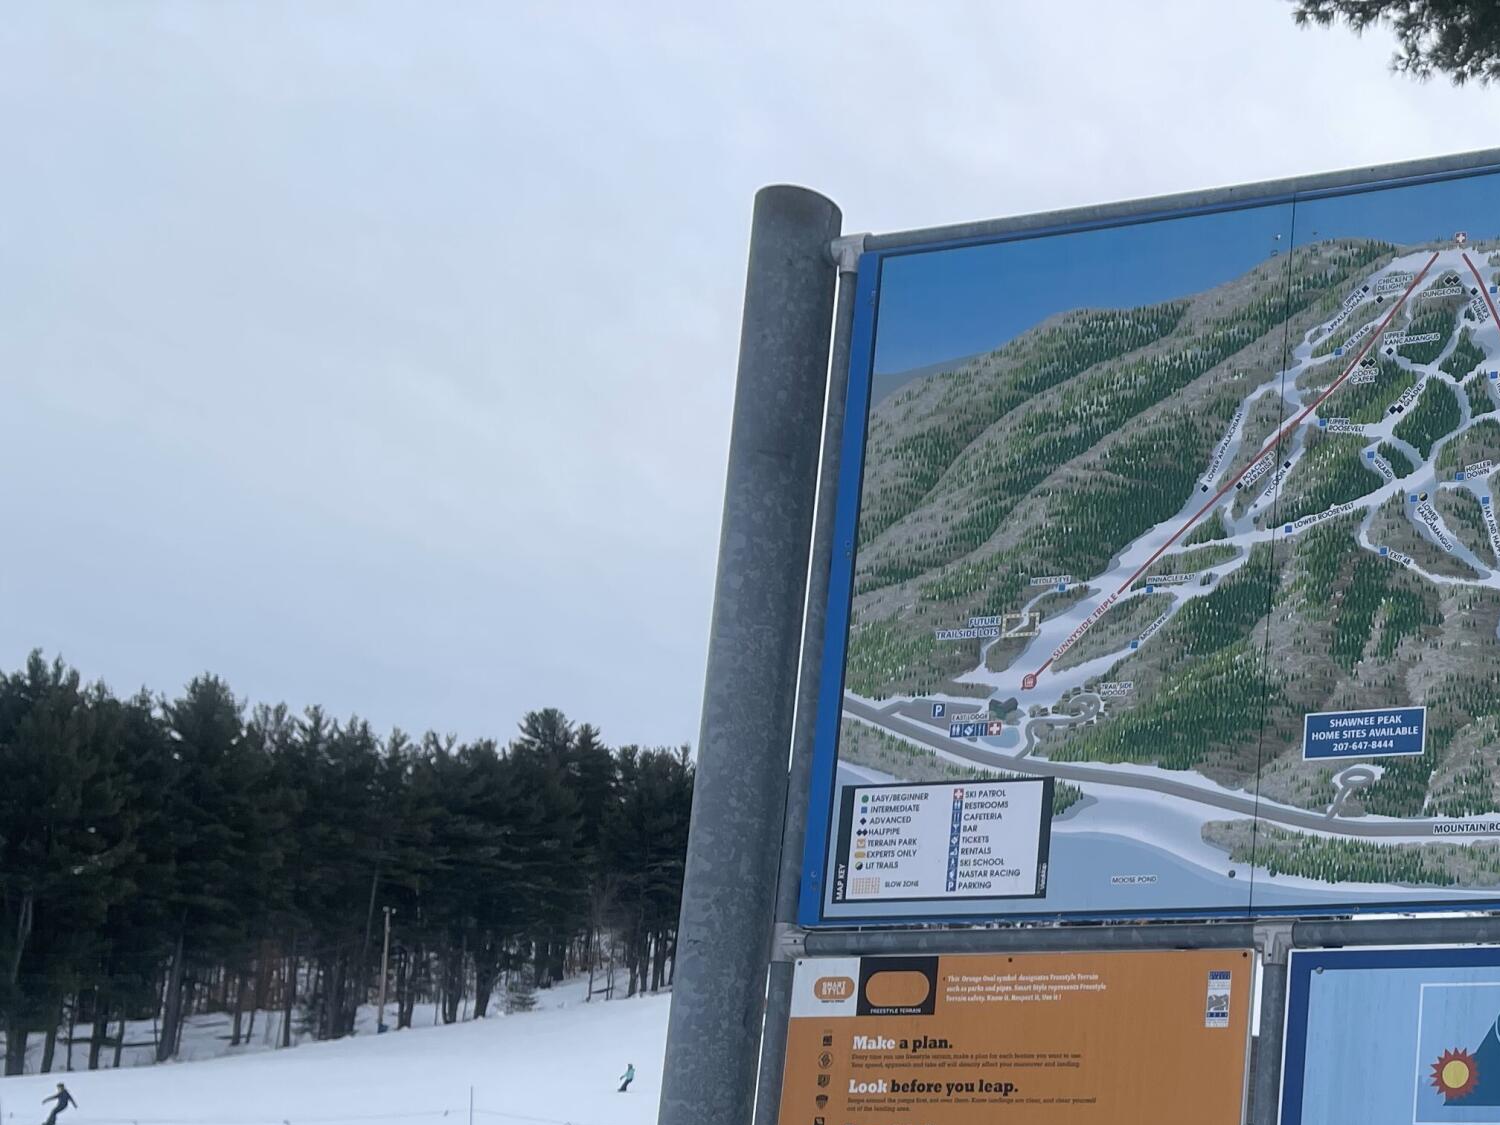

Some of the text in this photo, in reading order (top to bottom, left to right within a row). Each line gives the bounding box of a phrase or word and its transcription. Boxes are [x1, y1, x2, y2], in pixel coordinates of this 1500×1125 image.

[969, 617, 1000, 627] FUTURE
[1052, 592, 1118, 659] SUNNYSIDE TRIPLE
[936, 627, 999, 640] TRAILSIDE LOTS
[1329, 715, 1402, 727] SHAWNEE PEAK
[1311, 725, 1419, 741] HOME SITES AVAILABLE
[1332, 740, 1394, 752] 207-647-8444
[871, 793, 929, 801] EASY/BEGINNER
[978, 790, 1006, 798] PATROL
[870, 805, 920, 814] INTERMEDIATE
[964, 801, 1009, 810] RESTROOMS
[869, 816, 912, 825] ADVANCED
[963, 812, 1002, 821] CAFETERIA
[868, 828, 901, 836] HALFPIPE
[1434, 823, 1486, 834] MOUNTAIN
[867, 838, 917, 847] TERRAIN PARK
[962, 836, 990, 844] TICKETS
[866, 850, 895, 858] EXPERTS
[960, 847, 992, 855] RENTALS
[876, 861, 899, 869] TRAILS
[973, 858, 1004, 866] SCHOOL
[959, 869, 1021, 878] NASTAR RACING
[958, 881, 992, 889] PARKING
[852, 1035, 953, 1053] Make a plan.
[848, 1079, 1019, 1097] Look before you leap.
